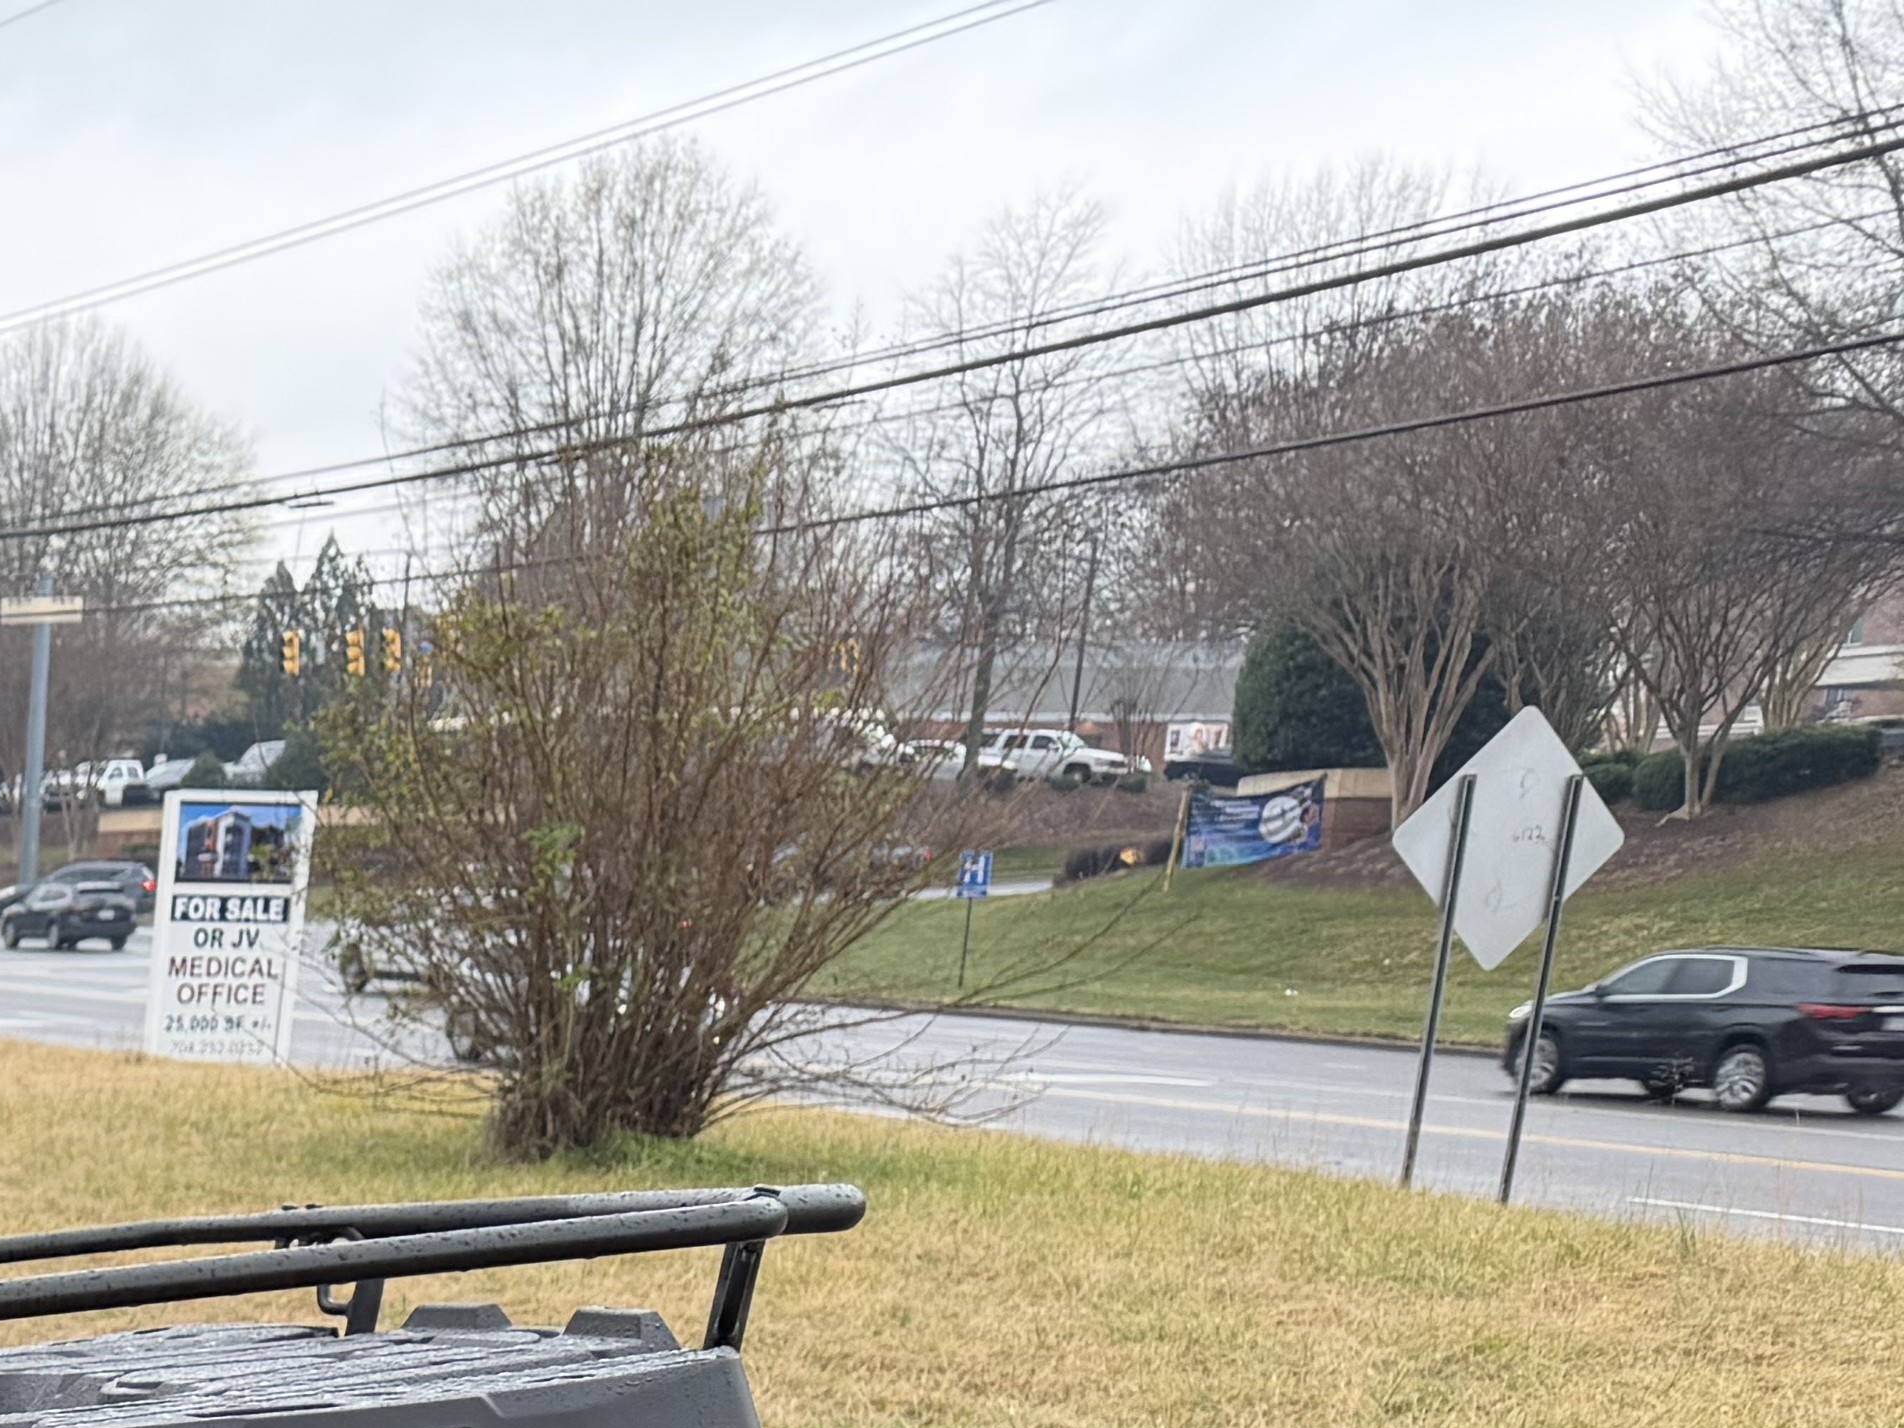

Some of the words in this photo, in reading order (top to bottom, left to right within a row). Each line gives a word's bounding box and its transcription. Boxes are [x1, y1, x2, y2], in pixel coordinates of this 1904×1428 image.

[174, 896, 221, 920] FOR
[224, 897, 285, 921] SALE
[193, 928, 223, 949] OR
[232, 928, 260, 949] JV
[168, 955, 280, 981] MEDICAL
[177, 982, 266, 1006] OFFICE
